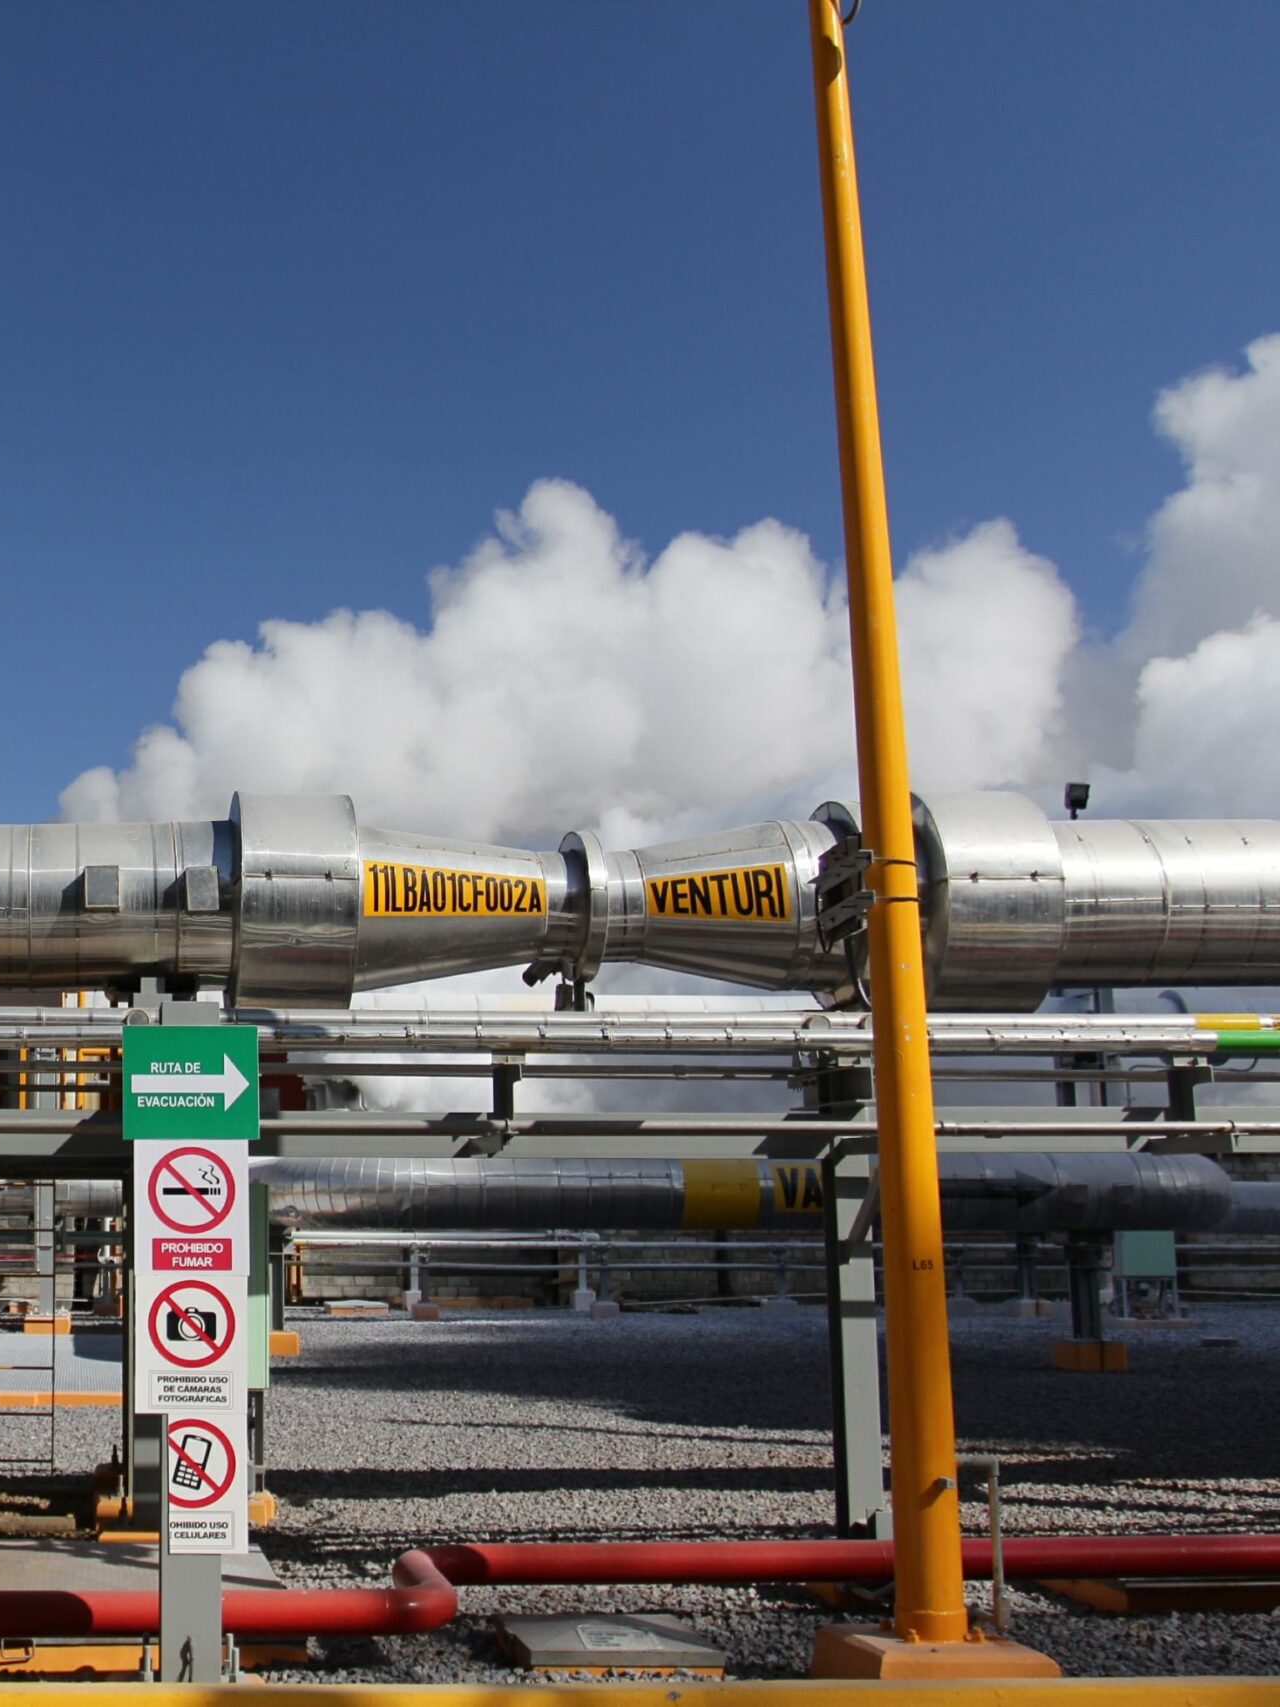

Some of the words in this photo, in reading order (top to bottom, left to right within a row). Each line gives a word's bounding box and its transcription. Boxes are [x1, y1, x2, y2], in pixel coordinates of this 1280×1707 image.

[369, 864, 542, 914] 11LBA01CF002A
[651, 867, 786, 920] VENTURI
[150, 1062, 182, 1073] RUTA
[185, 1062, 201, 1073] DE
[137, 1093, 215, 1107] EVACUACIÓN
[776, 1167, 823, 1208] VA
[161, 1242, 224, 1253] PROHIBIDO
[172, 1256, 213, 1267] FUMAR
[912, 1260, 934, 1270] L65
[157, 1375, 207, 1384] PROHIBIDO
[209, 1376, 228, 1384] USO
[163, 1385, 176, 1393] DE
[169, 1521, 208, 1529] OHIBIDO
[209, 1521, 229, 1529] USO
[174, 1531, 227, 1539] CELULARES
